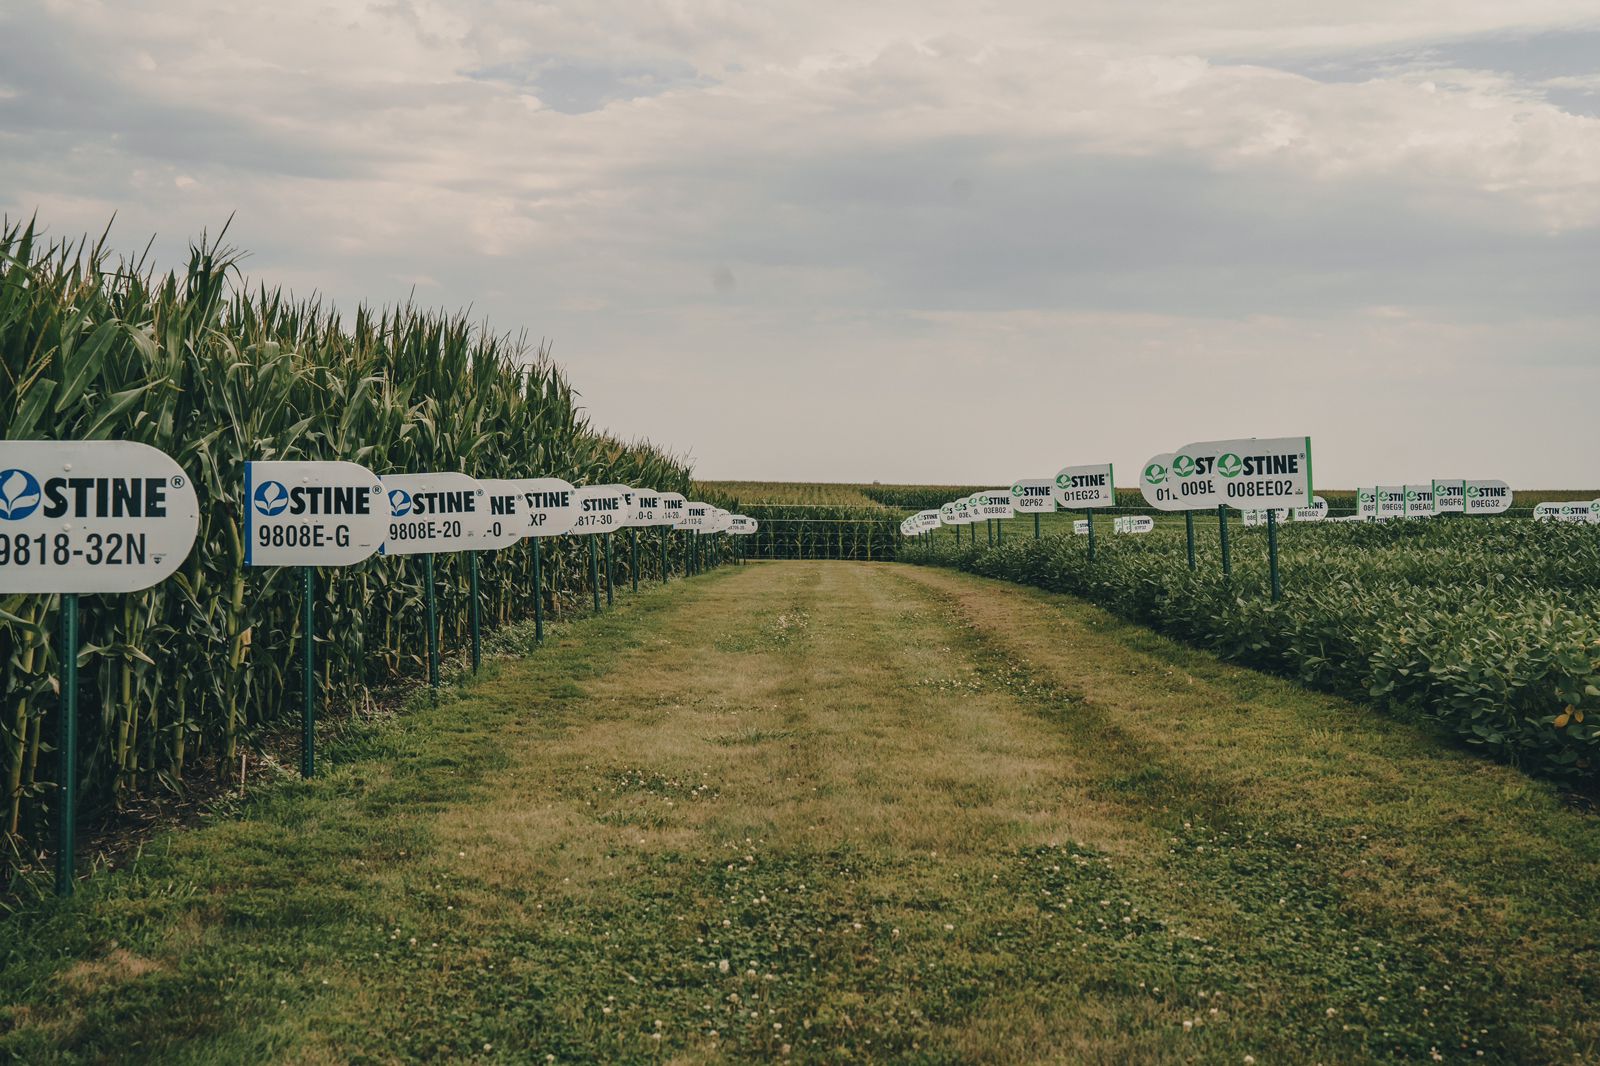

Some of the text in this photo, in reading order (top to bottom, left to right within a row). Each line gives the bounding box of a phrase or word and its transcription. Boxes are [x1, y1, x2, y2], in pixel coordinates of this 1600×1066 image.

[1023, 486, 1051, 497] STINE
[1227, 480, 1293, 498] 008EE02
[1478, 487, 1506, 497] STINE
[988, 497, 1010, 505] STINE
[1064, 490, 1100, 502] 01EG23
[1020, 498, 1043, 507] 02P62
[1470, 499, 1500, 508] 09EG32
[574, 514, 613, 527] 817-30
[259, 524, 350, 547] 9808E-G
[389, 520, 461, 541] 9808E-20
[0, 533, 146, 565] 9818-32N
